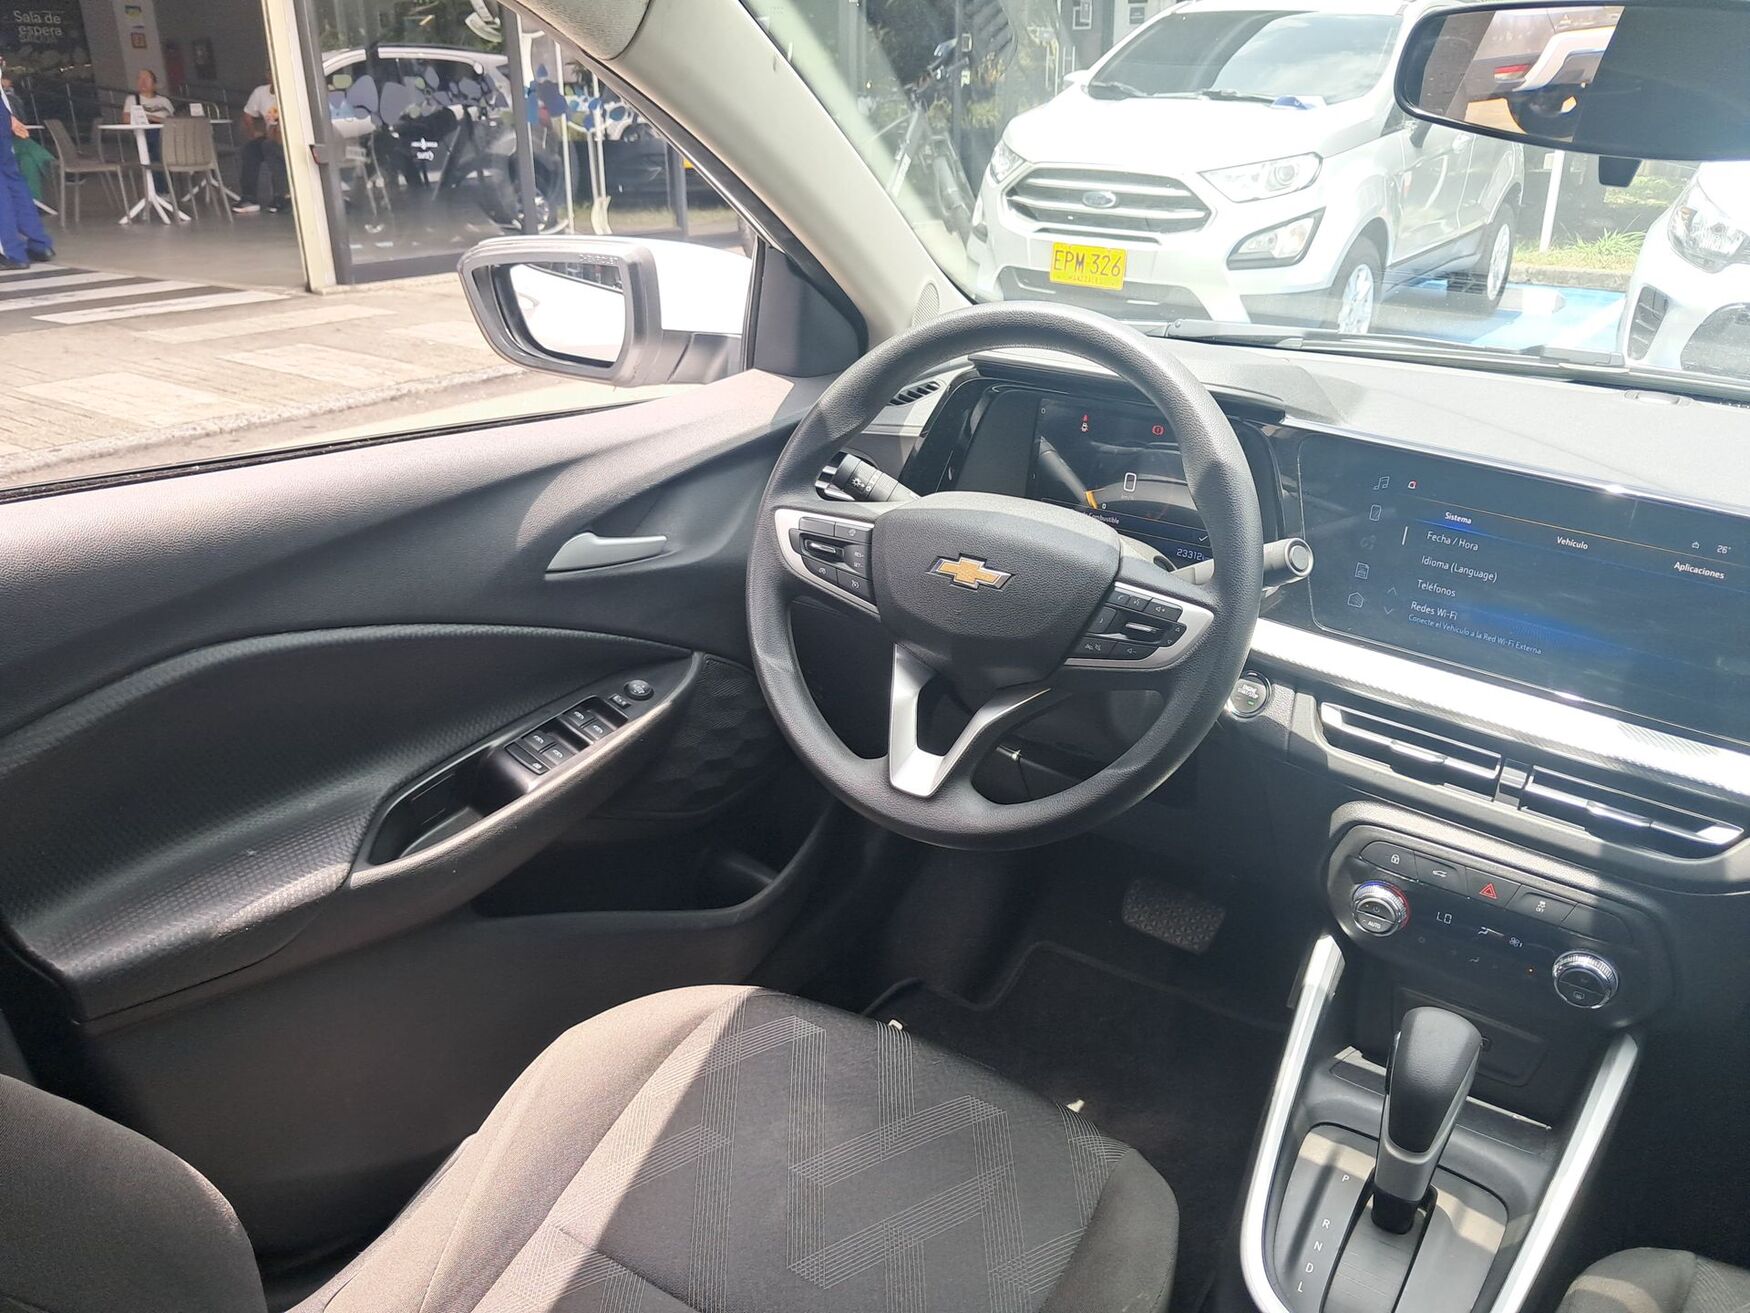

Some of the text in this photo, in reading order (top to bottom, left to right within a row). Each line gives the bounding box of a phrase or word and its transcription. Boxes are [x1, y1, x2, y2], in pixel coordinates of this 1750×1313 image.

[13, 10, 61, 24] Sala de
[1053, 249, 1122, 277] EPM 326
[1444, 511, 1472, 525] Sistema
[1426, 530, 1451, 545] Fecha
[1459, 539, 1479, 551] Hora
[1421, 555, 1498, 583] Idioma (Language)
[1673, 561, 1726, 579] Aplicaciones
[1417, 579, 1456, 597] Teléfonos
[1410, 601, 1458, 620] Redes Wi-Fi
[1408, 614, 1434, 627] Conecte
[1483, 633, 1497, 643] Red
[1515, 641, 1542, 655] Externa
[1436, 911, 1453, 925] LO
[1341, 1174, 1350, 1182] P
[1321, 1218, 1331, 1229] R
[1313, 1240, 1323, 1252] N
[1305, 1262, 1314, 1273] D
[1297, 1281, 1303, 1293] L
